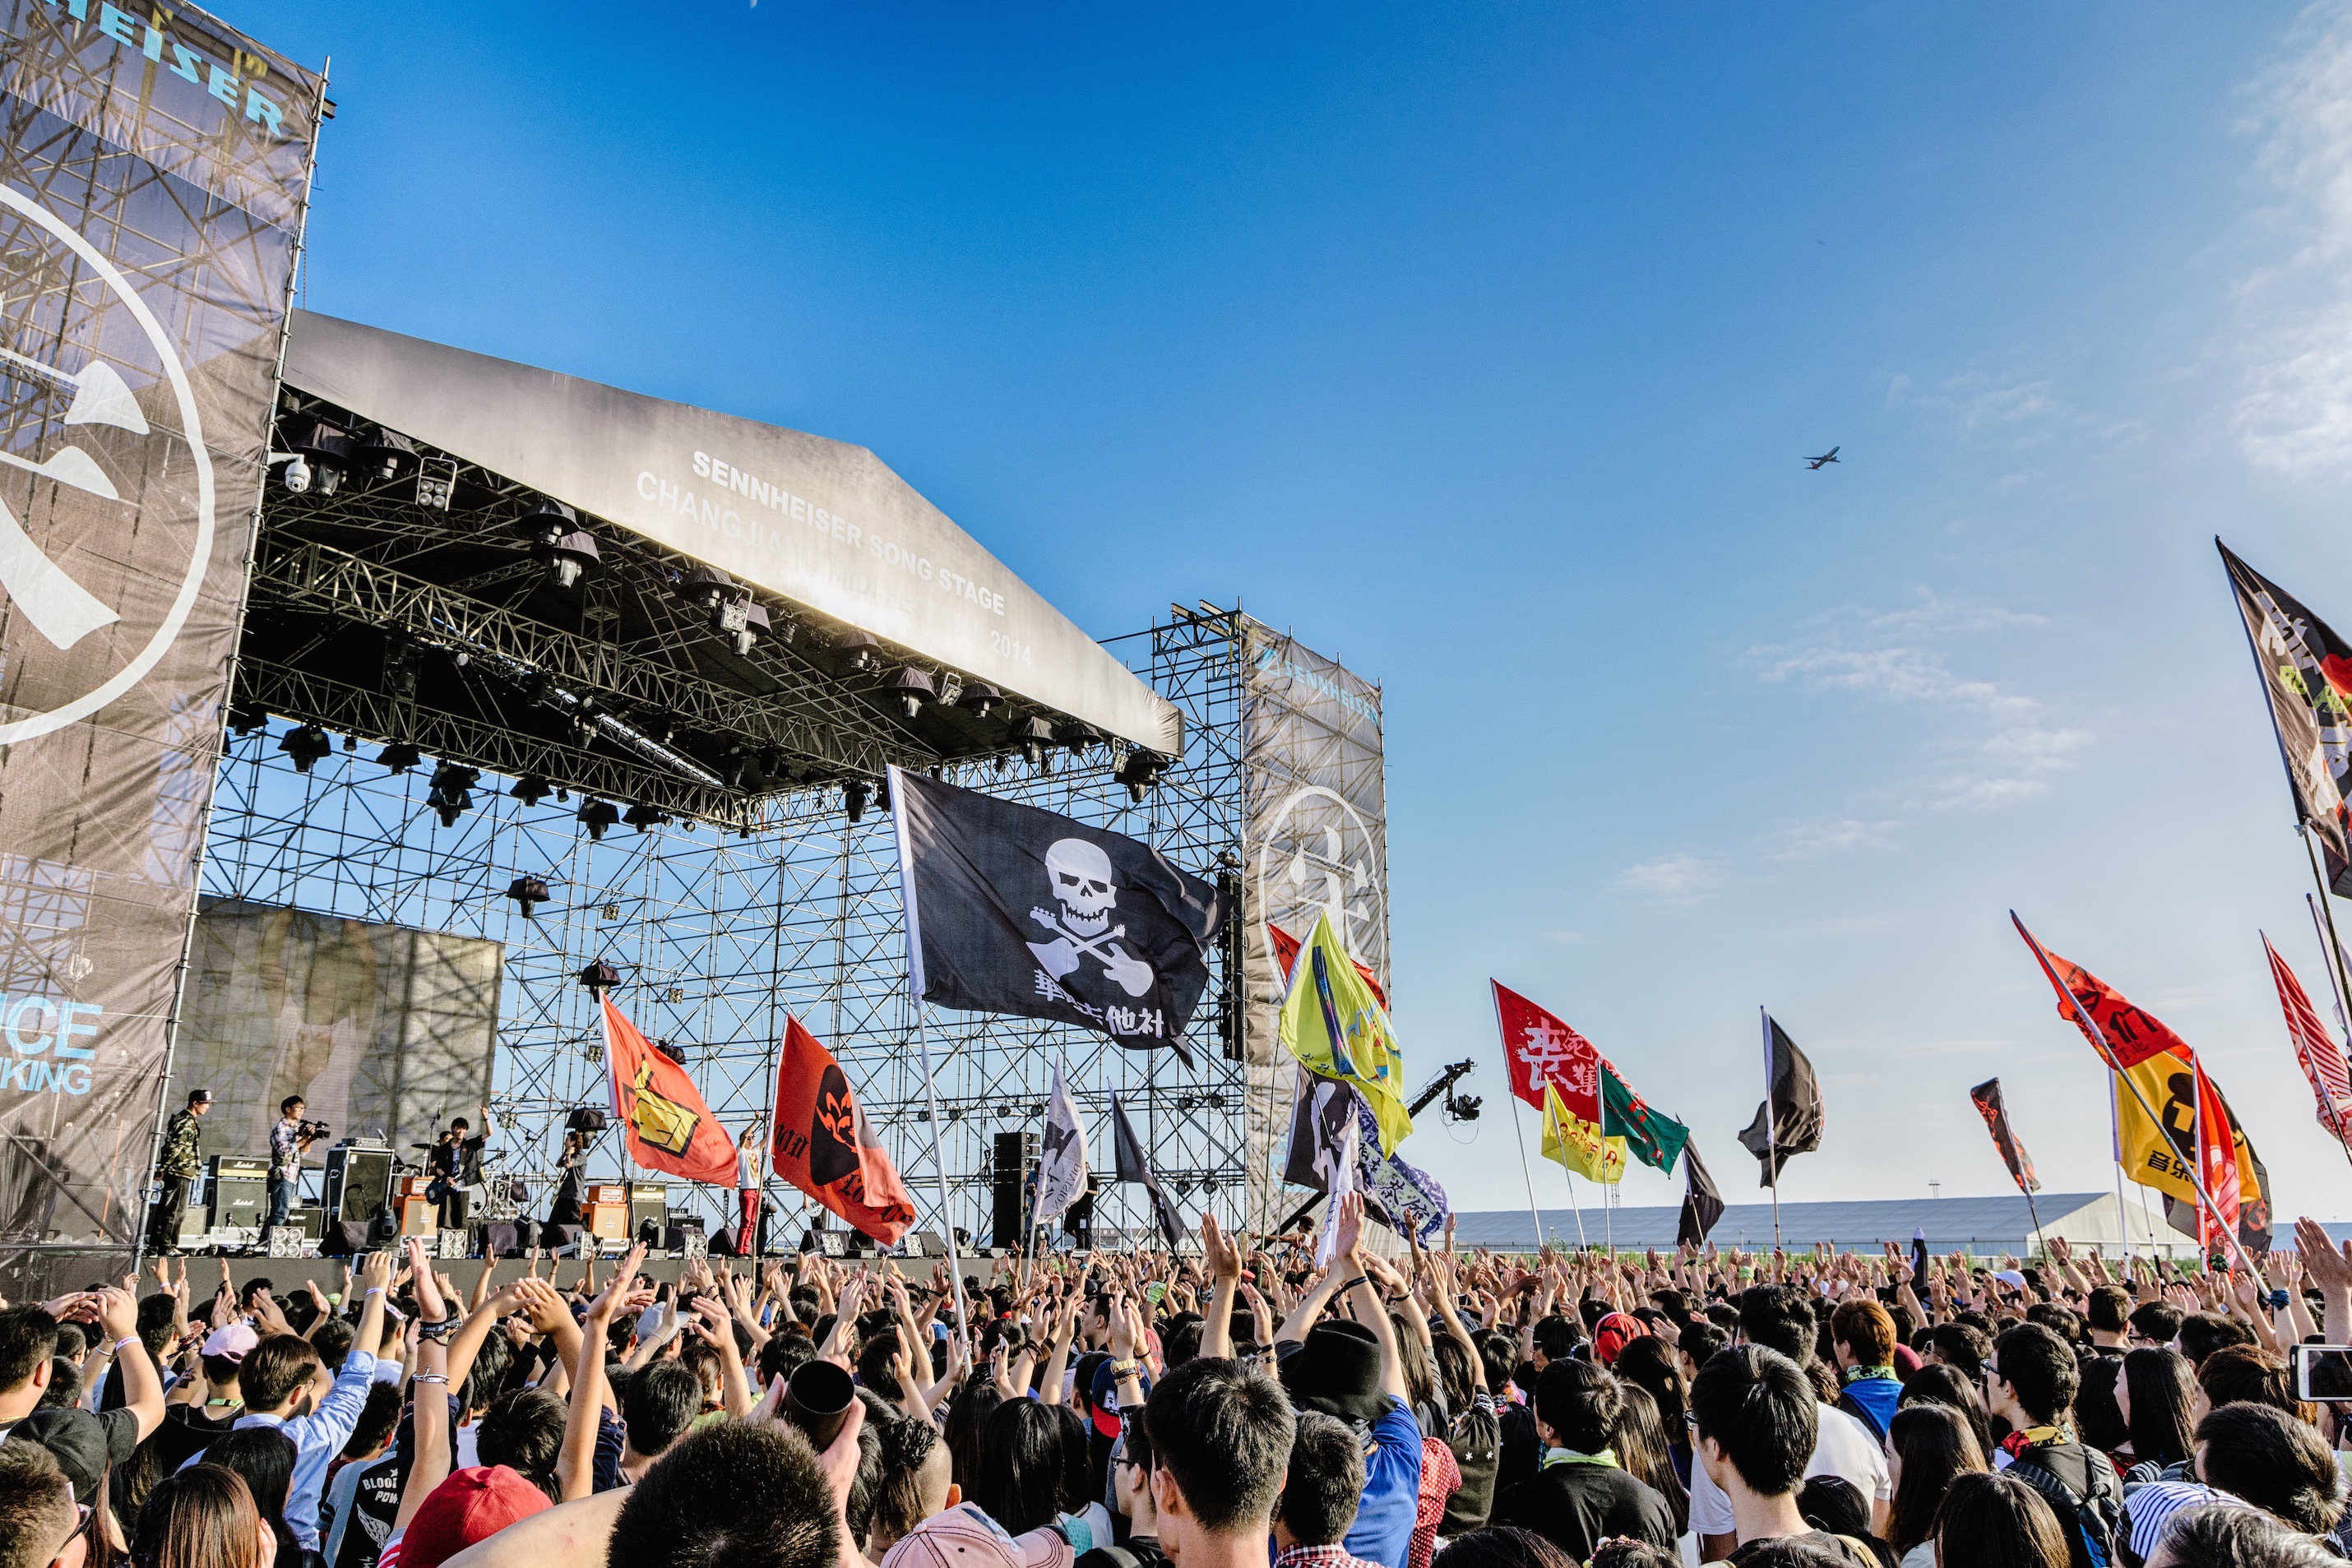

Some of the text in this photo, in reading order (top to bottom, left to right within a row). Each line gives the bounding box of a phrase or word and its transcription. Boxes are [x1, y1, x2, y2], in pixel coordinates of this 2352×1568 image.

[692, 451, 1005, 617] SENNHEISER SONG STAGE
[989, 629, 1033, 668] 2014
[1285, 659, 1379, 725] SENNHEISER
[0, 1056, 92, 1095] KING
